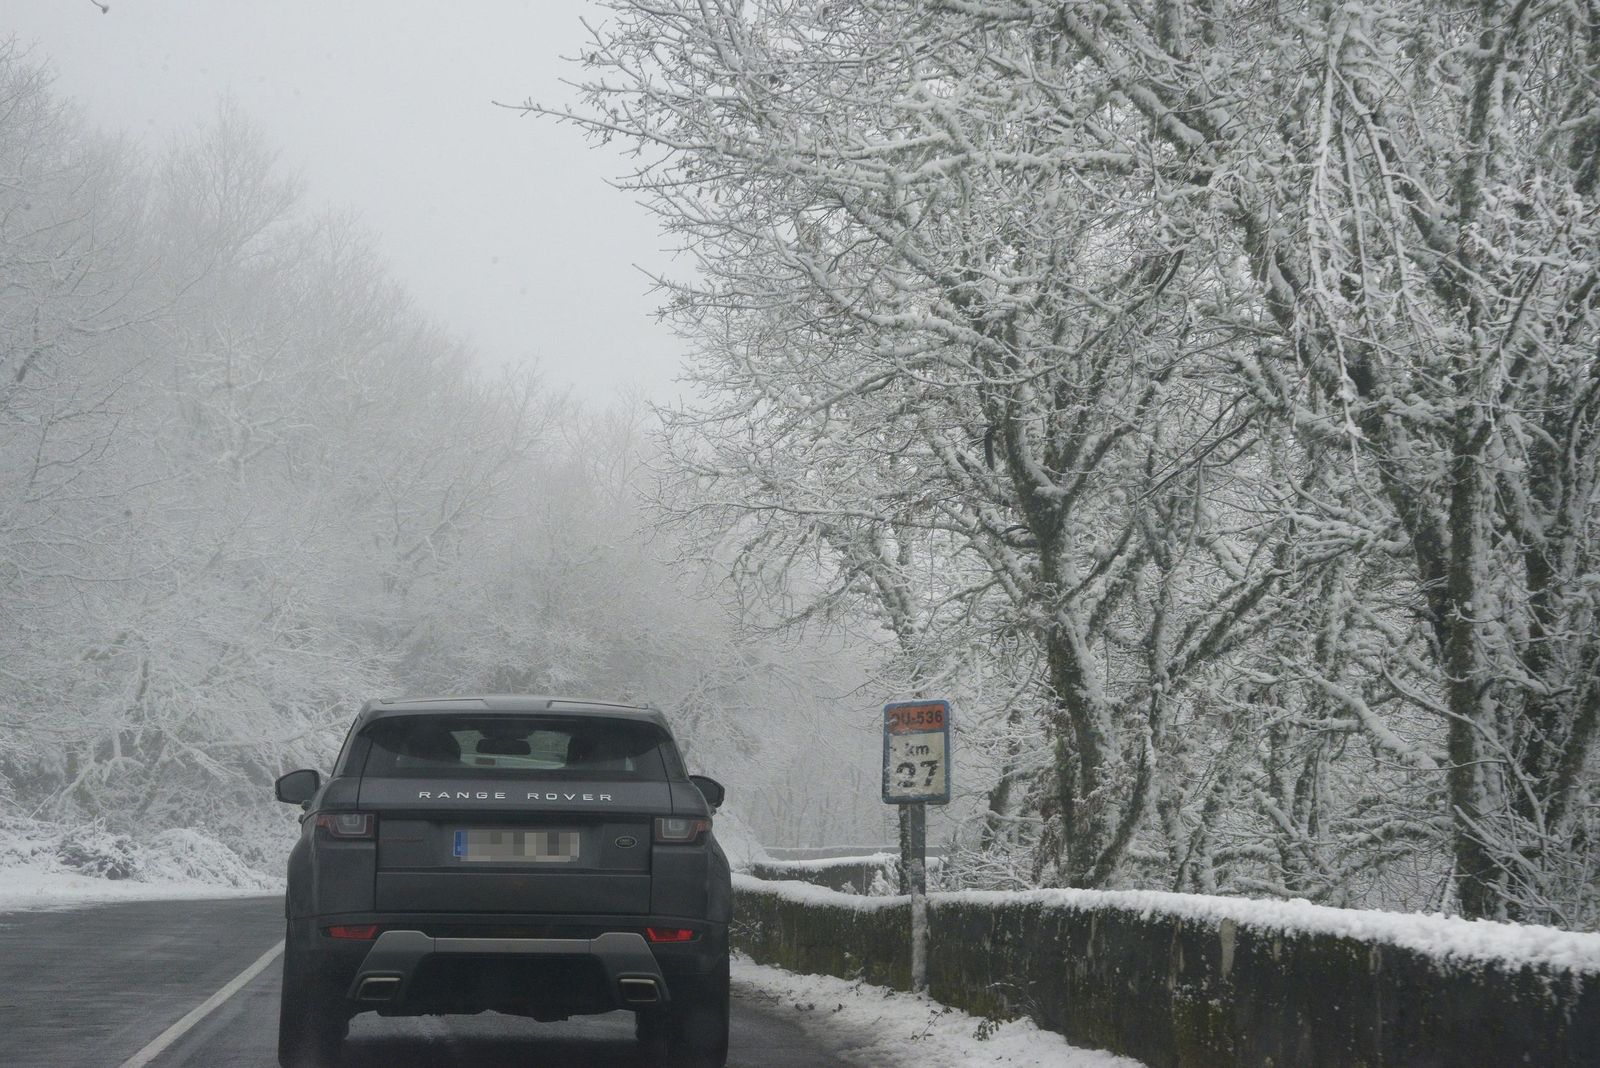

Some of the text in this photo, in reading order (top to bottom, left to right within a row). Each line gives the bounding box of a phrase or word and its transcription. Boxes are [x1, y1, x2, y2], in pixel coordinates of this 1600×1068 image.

[905, 742, 930, 757] km
[896, 760, 938, 788] 27
[418, 791, 612, 801] RANGE ROVER
